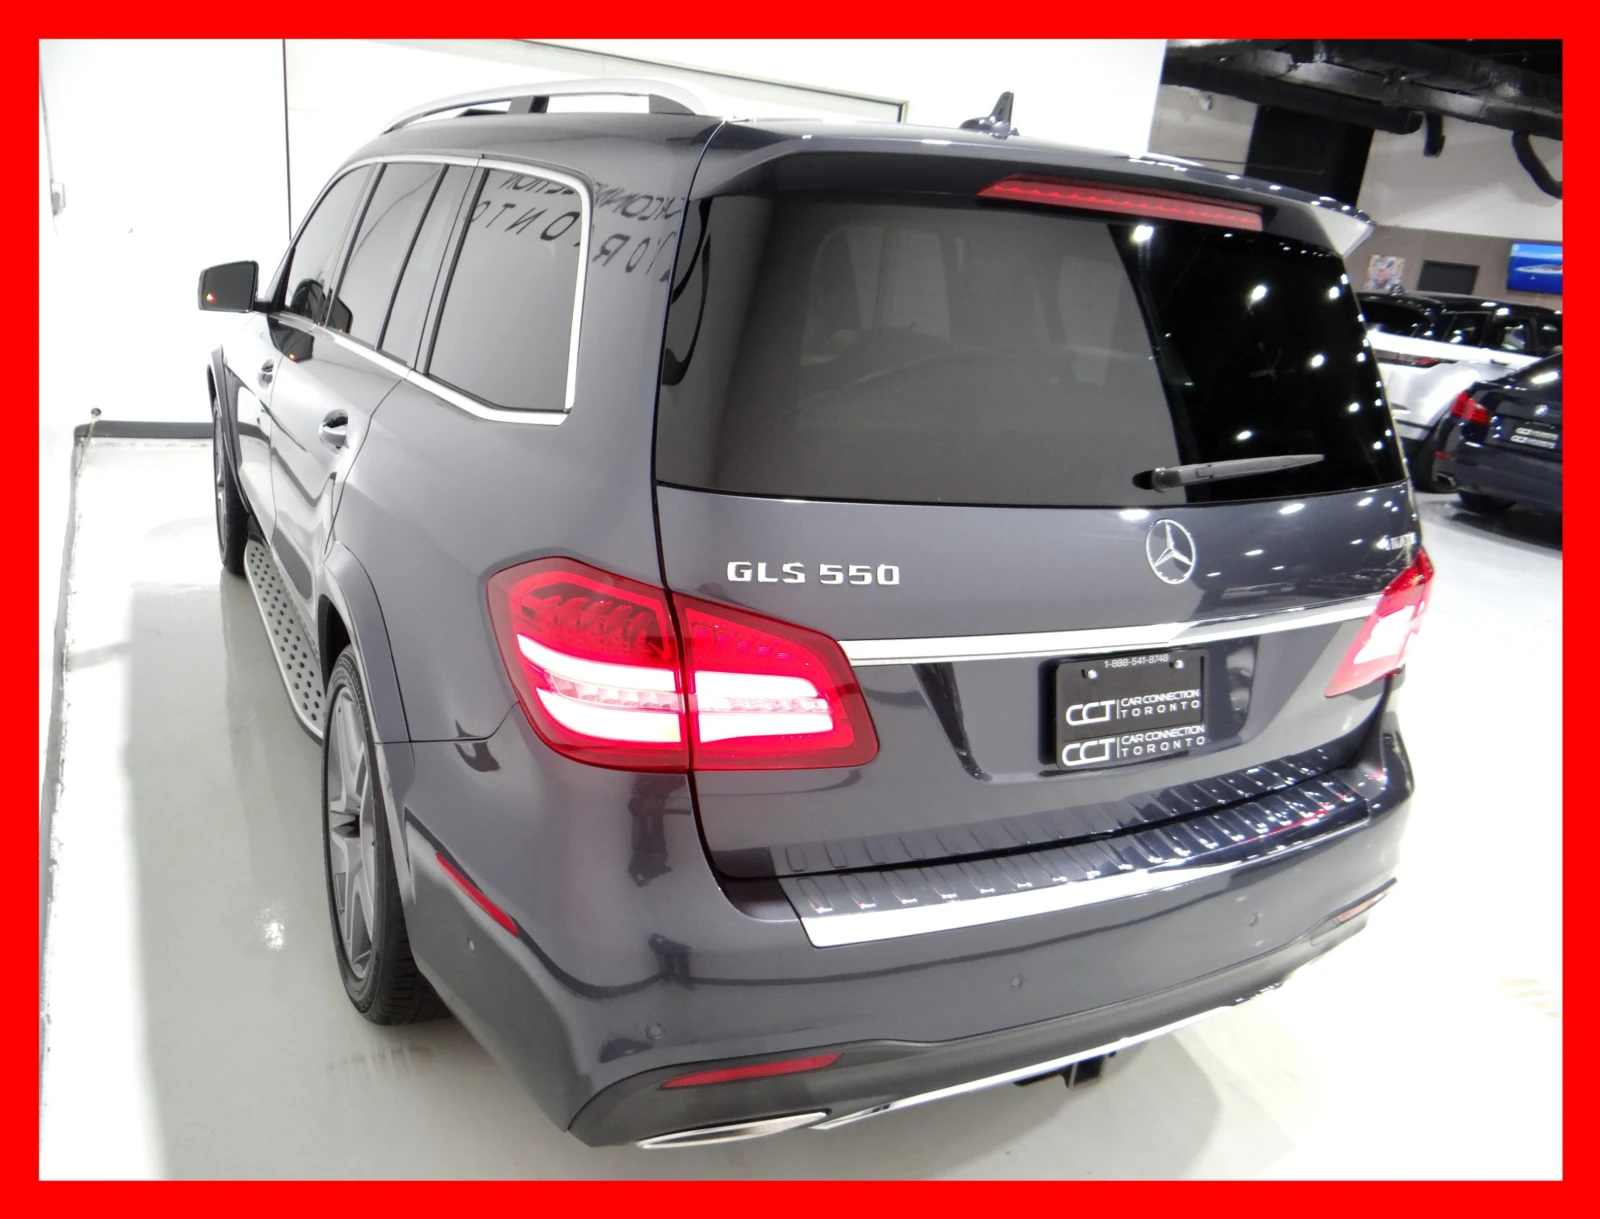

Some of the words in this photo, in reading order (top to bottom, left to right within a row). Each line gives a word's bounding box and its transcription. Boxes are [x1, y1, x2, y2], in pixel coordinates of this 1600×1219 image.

[727, 562, 806, 583] GLS
[819, 563, 901, 586] 550
[1104, 653, 1169, 669] 1-888-541-8748
[1120, 696, 1142, 707] CAR
[1142, 688, 1201, 704] CONNECTION
[1066, 700, 1116, 726] CCT
[1120, 699, 1201, 718] TORONTO
[1121, 733, 1144, 745] CAR
[1144, 724, 1205, 742] CONNECTION
[1062, 738, 1116, 767] CCT
[1120, 736, 1206, 757] TORONTO
